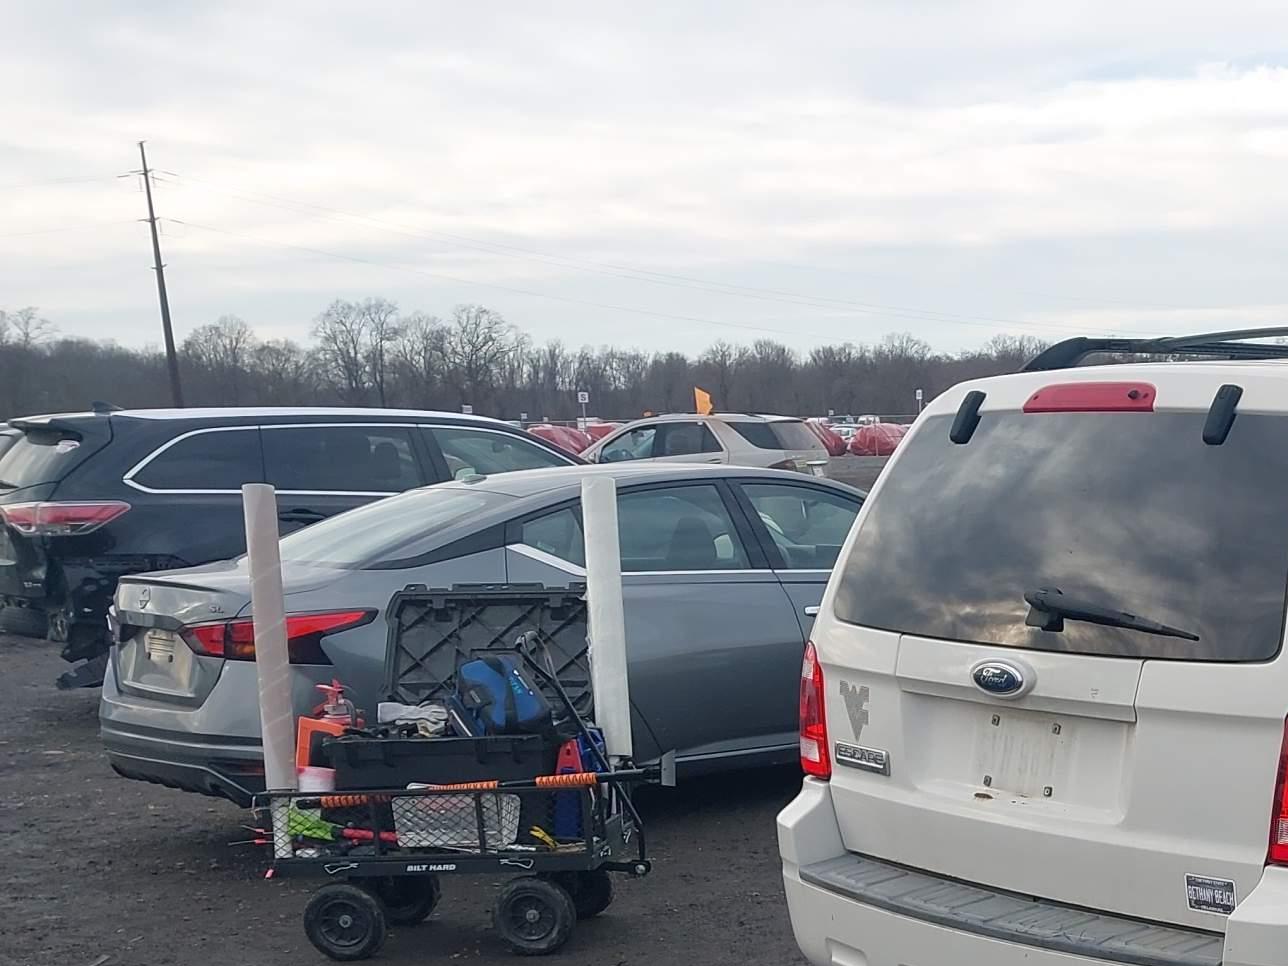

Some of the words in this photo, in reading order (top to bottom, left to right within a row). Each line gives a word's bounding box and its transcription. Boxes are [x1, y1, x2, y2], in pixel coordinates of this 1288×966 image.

[838, 743, 885, 765] ESCAPE
[1187, 885, 1214, 905] BETHANY
[1214, 889, 1235, 907] BEACH
